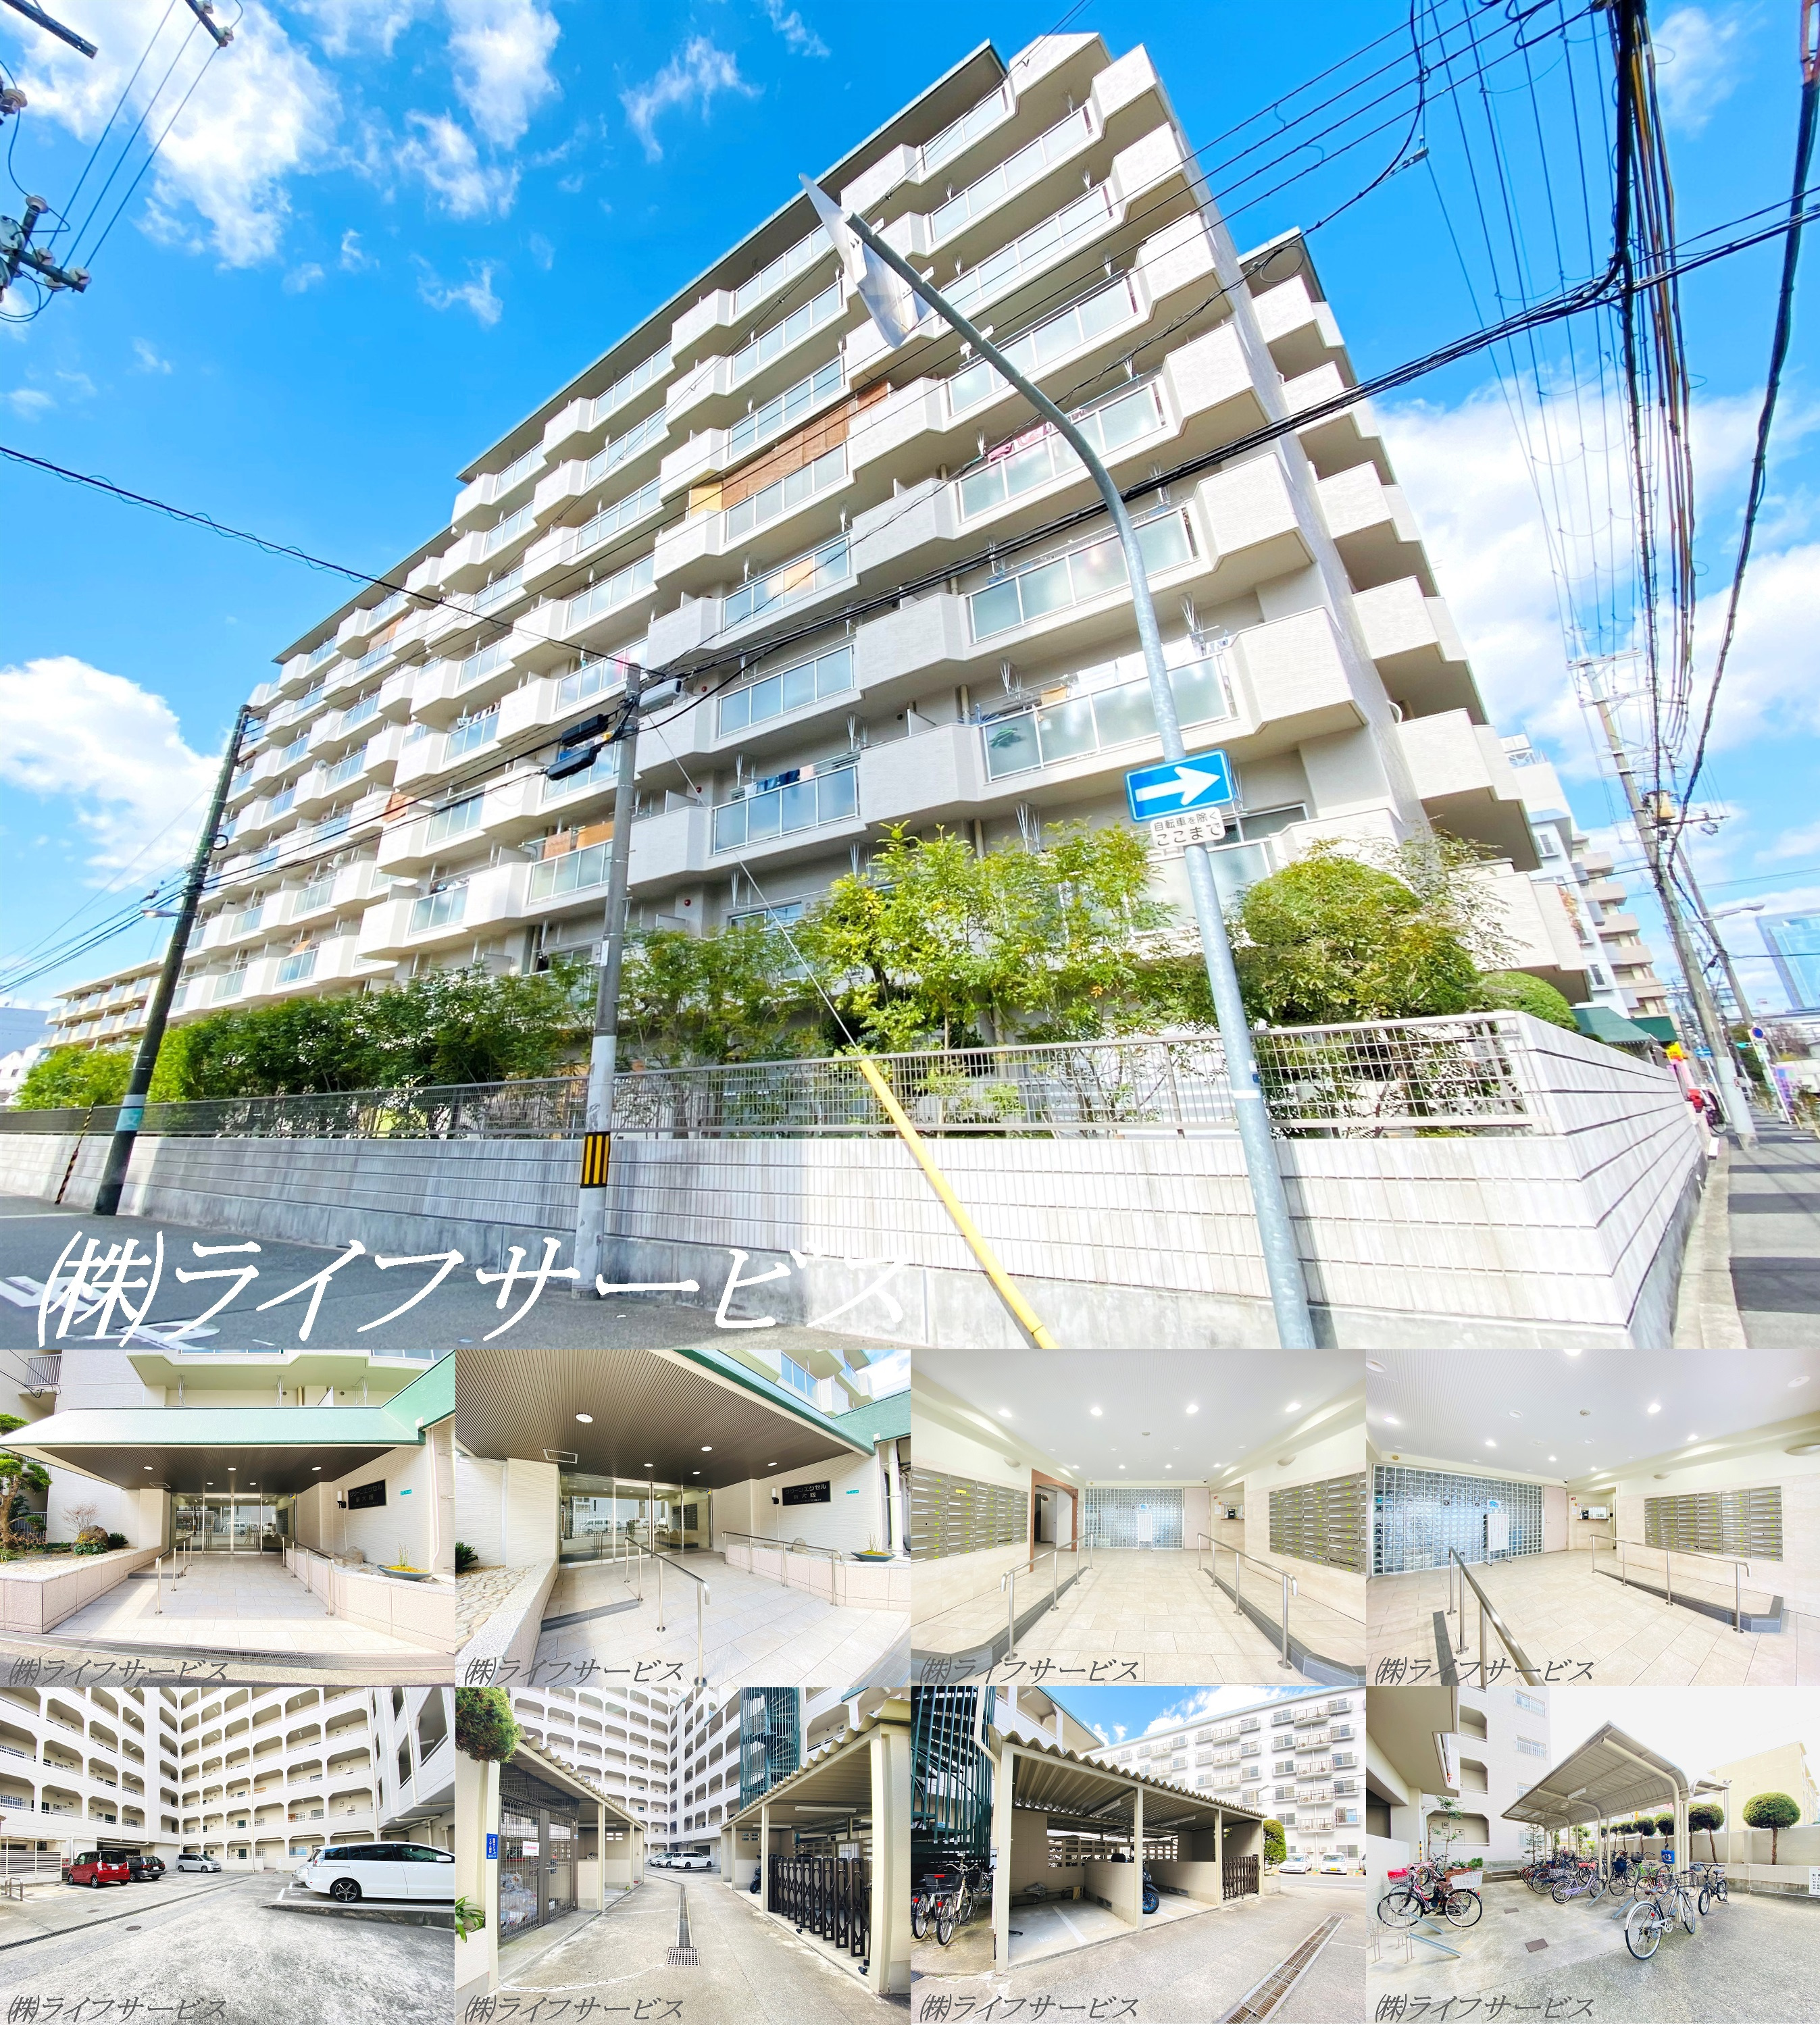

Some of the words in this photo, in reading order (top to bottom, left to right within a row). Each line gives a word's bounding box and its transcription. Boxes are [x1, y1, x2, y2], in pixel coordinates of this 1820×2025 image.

[1154, 813, 1218, 831] 自転車を除く
[1157, 823, 1221, 846] ここまで
